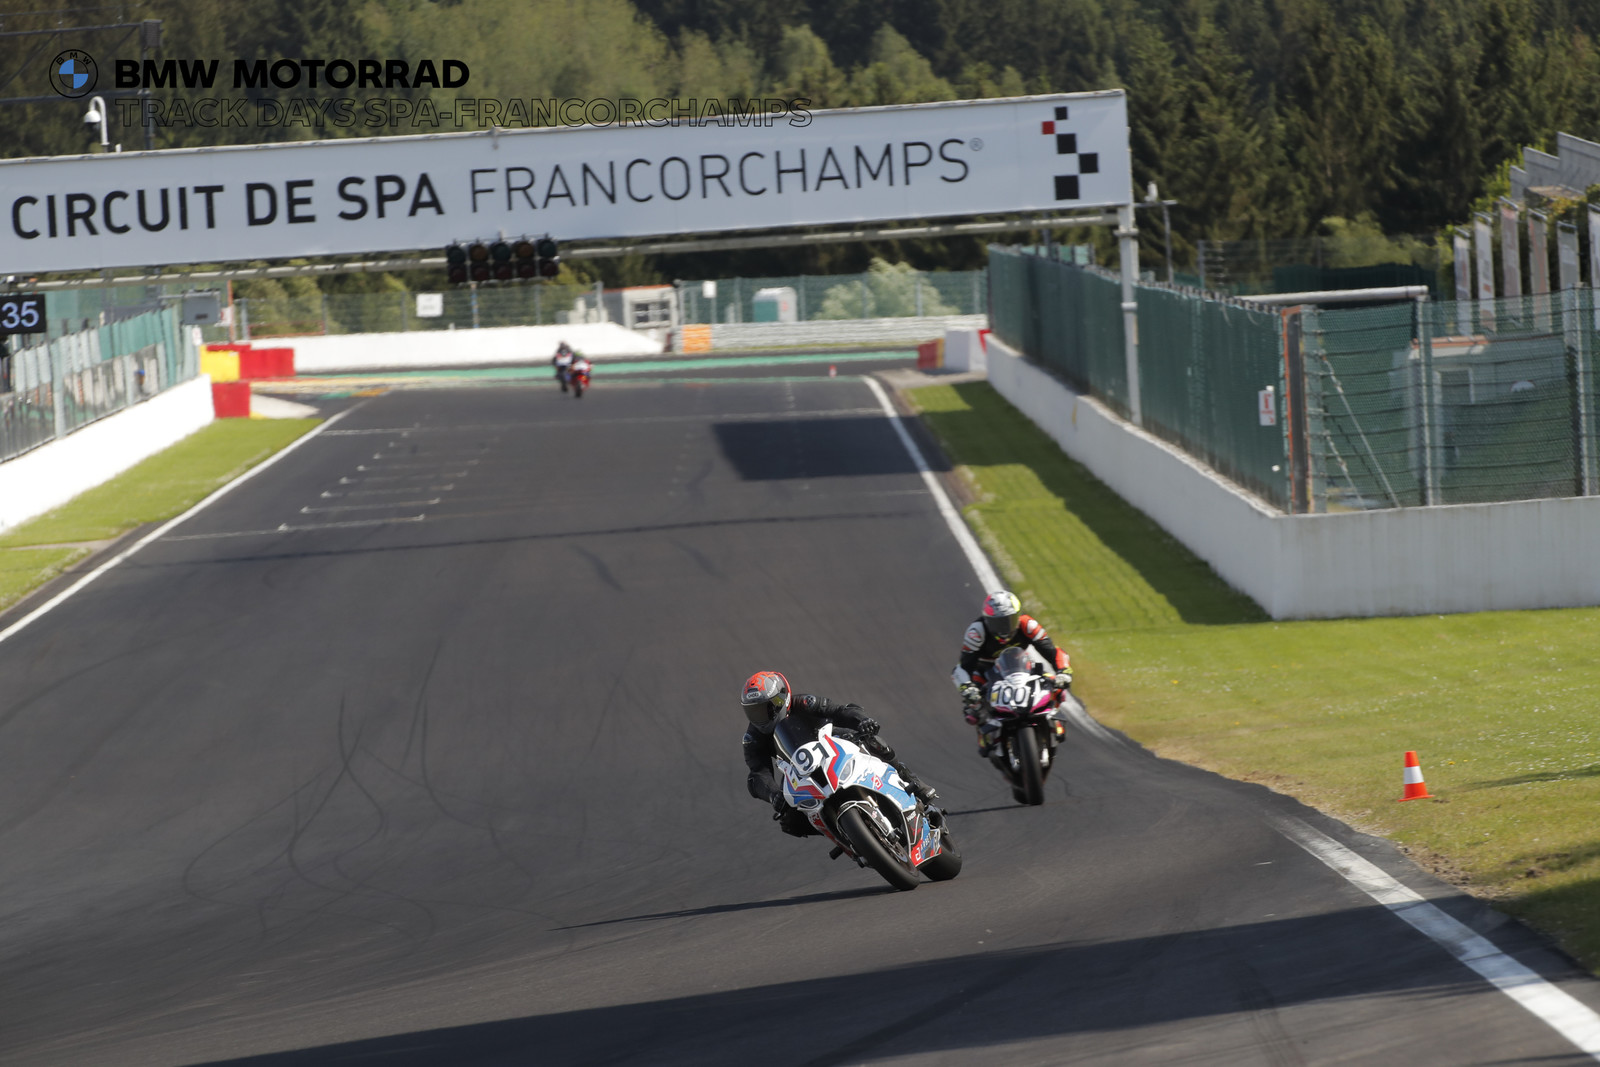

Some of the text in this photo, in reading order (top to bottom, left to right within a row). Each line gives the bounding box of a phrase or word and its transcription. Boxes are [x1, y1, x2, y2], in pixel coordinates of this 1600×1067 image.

[11, 137, 970, 240] CIRCUIT DE SPA FRANCORCHAMPS
[992, 685, 1027, 705] 100
[795, 742, 830, 772] 91
